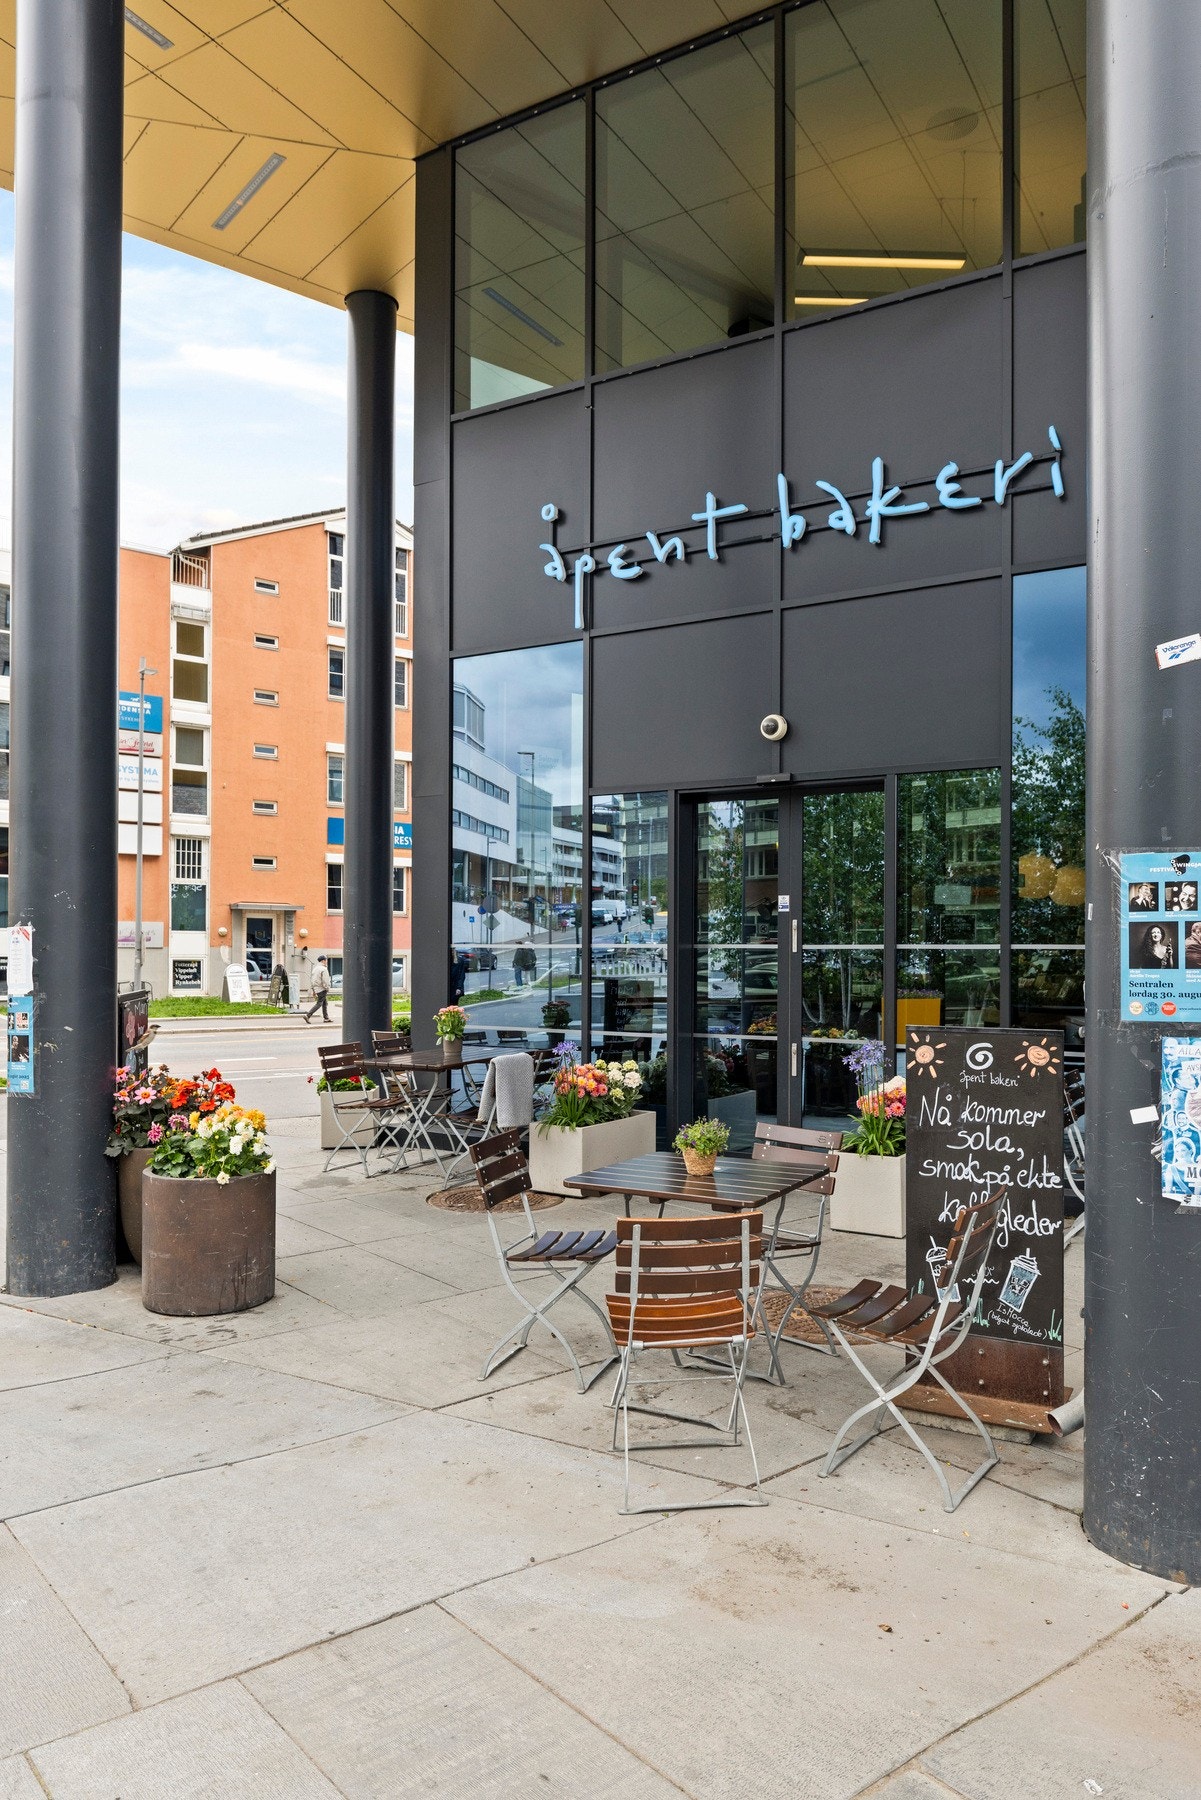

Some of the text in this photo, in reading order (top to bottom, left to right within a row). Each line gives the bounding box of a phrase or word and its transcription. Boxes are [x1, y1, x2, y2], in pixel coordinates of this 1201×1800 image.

[541, 425, 1065, 629] åpent bakeri
[1128, 980, 1174, 989] Sentralen
[1160, 991, 1176, 999] 30.
[919, 1086, 1046, 1128] Nå kommer
[946, 1124, 1025, 1161] sola,
[918, 1153, 1064, 1195] smak på ekte
